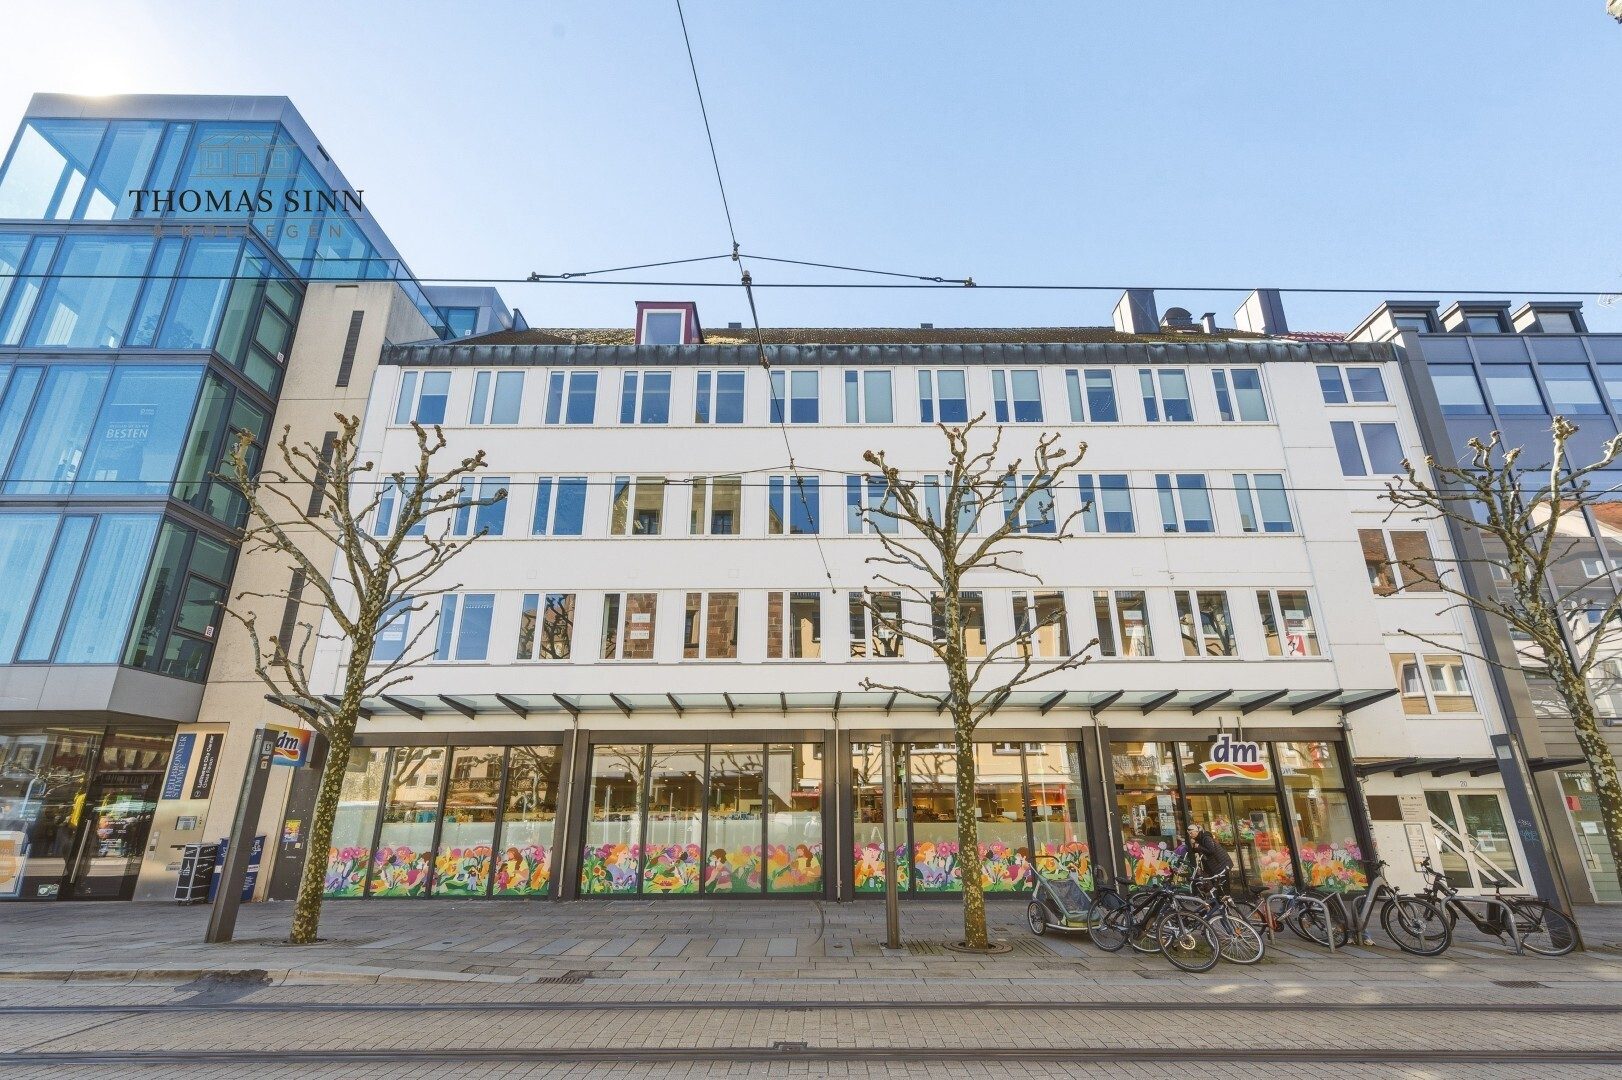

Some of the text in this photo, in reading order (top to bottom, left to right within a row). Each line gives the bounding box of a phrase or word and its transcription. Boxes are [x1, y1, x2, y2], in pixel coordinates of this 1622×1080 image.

[106, 428, 149, 439] BESTEN
[276, 731, 298, 749] dm
[1213, 736, 1257, 763] dm
[165, 736, 187, 797] HEILBRONNER
[172, 763, 187, 798] STIMME
